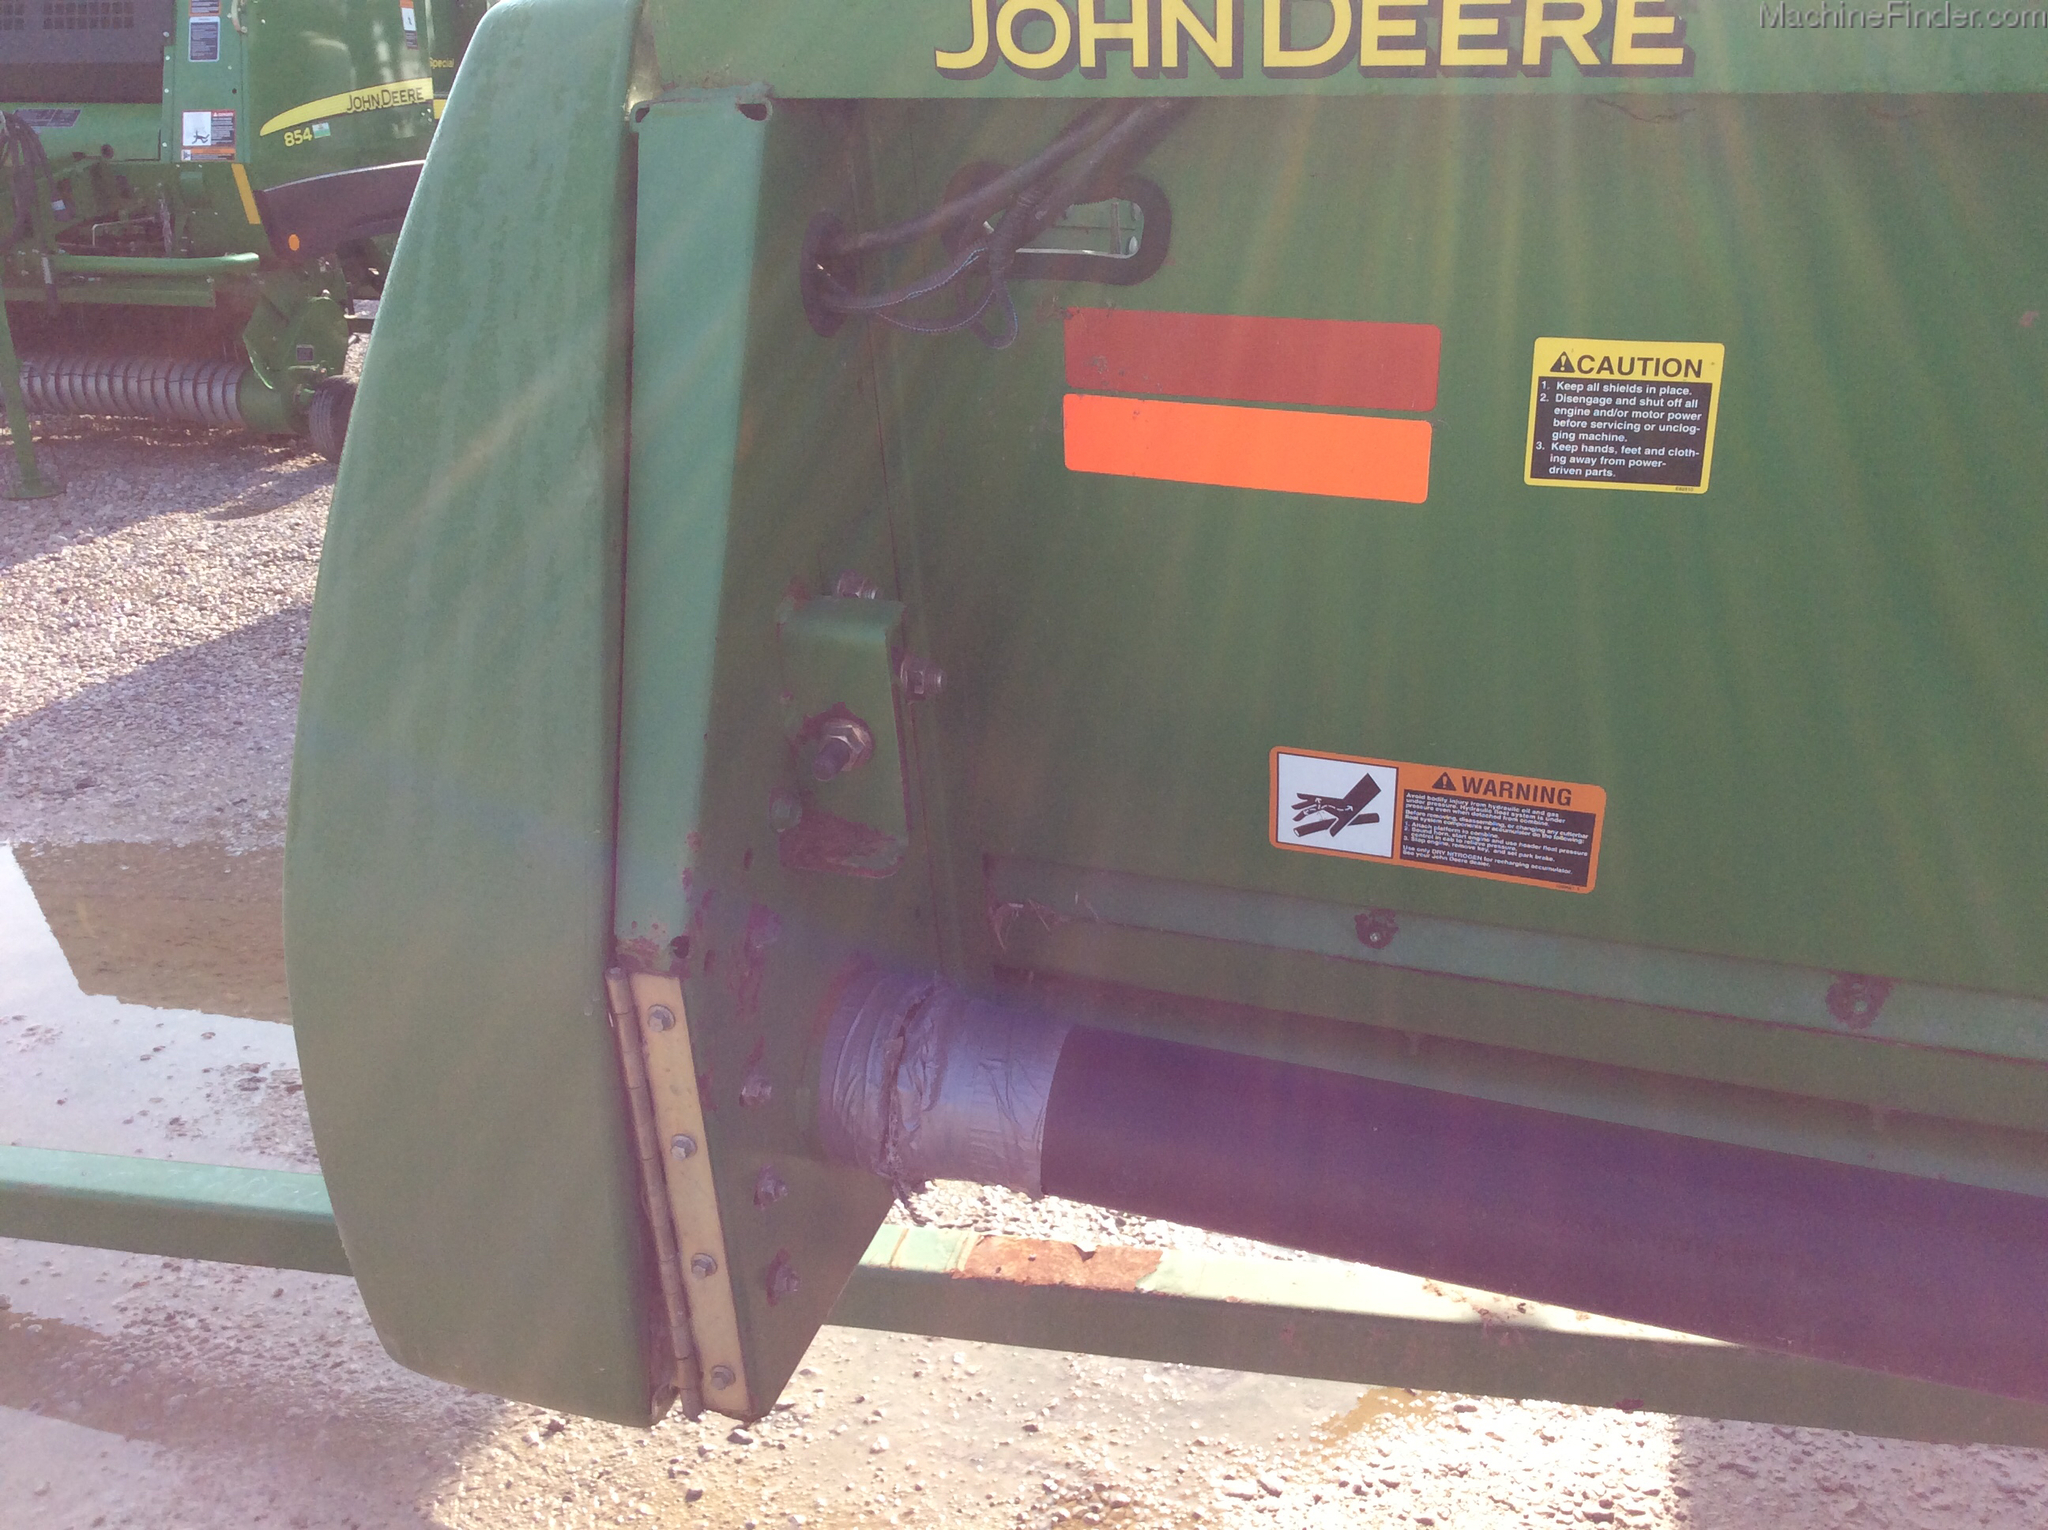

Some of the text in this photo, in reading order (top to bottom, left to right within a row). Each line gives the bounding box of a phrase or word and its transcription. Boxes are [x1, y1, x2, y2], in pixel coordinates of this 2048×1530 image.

[935, 0, 1692, 79] JOHN DEERE
[346, 87, 424, 112] JOHN DEERE
[284, 127, 312, 147] 854
[1577, 354, 1703, 378] CAUTION
[1542, 381, 1692, 398] 1. Keep all shields in place.
[1540, 393, 1698, 408] 2. Disengage and shut off all
[1554, 407, 1702, 422] engine and/or motor power
[1553, 419, 1587, 428] before
[1590, 420, 1641, 432] servicing
[1659, 423, 1700, 435] unclog-
[1552, 431, 1627, 442] ging machine.
[1536, 442, 1699, 457] 3. Keep hands, feet and cloth-
[1550, 455, 1666, 469] ing away from power-
[1549, 466, 1616, 478] driven parts.
[1463, 776, 1572, 807] WARNING
